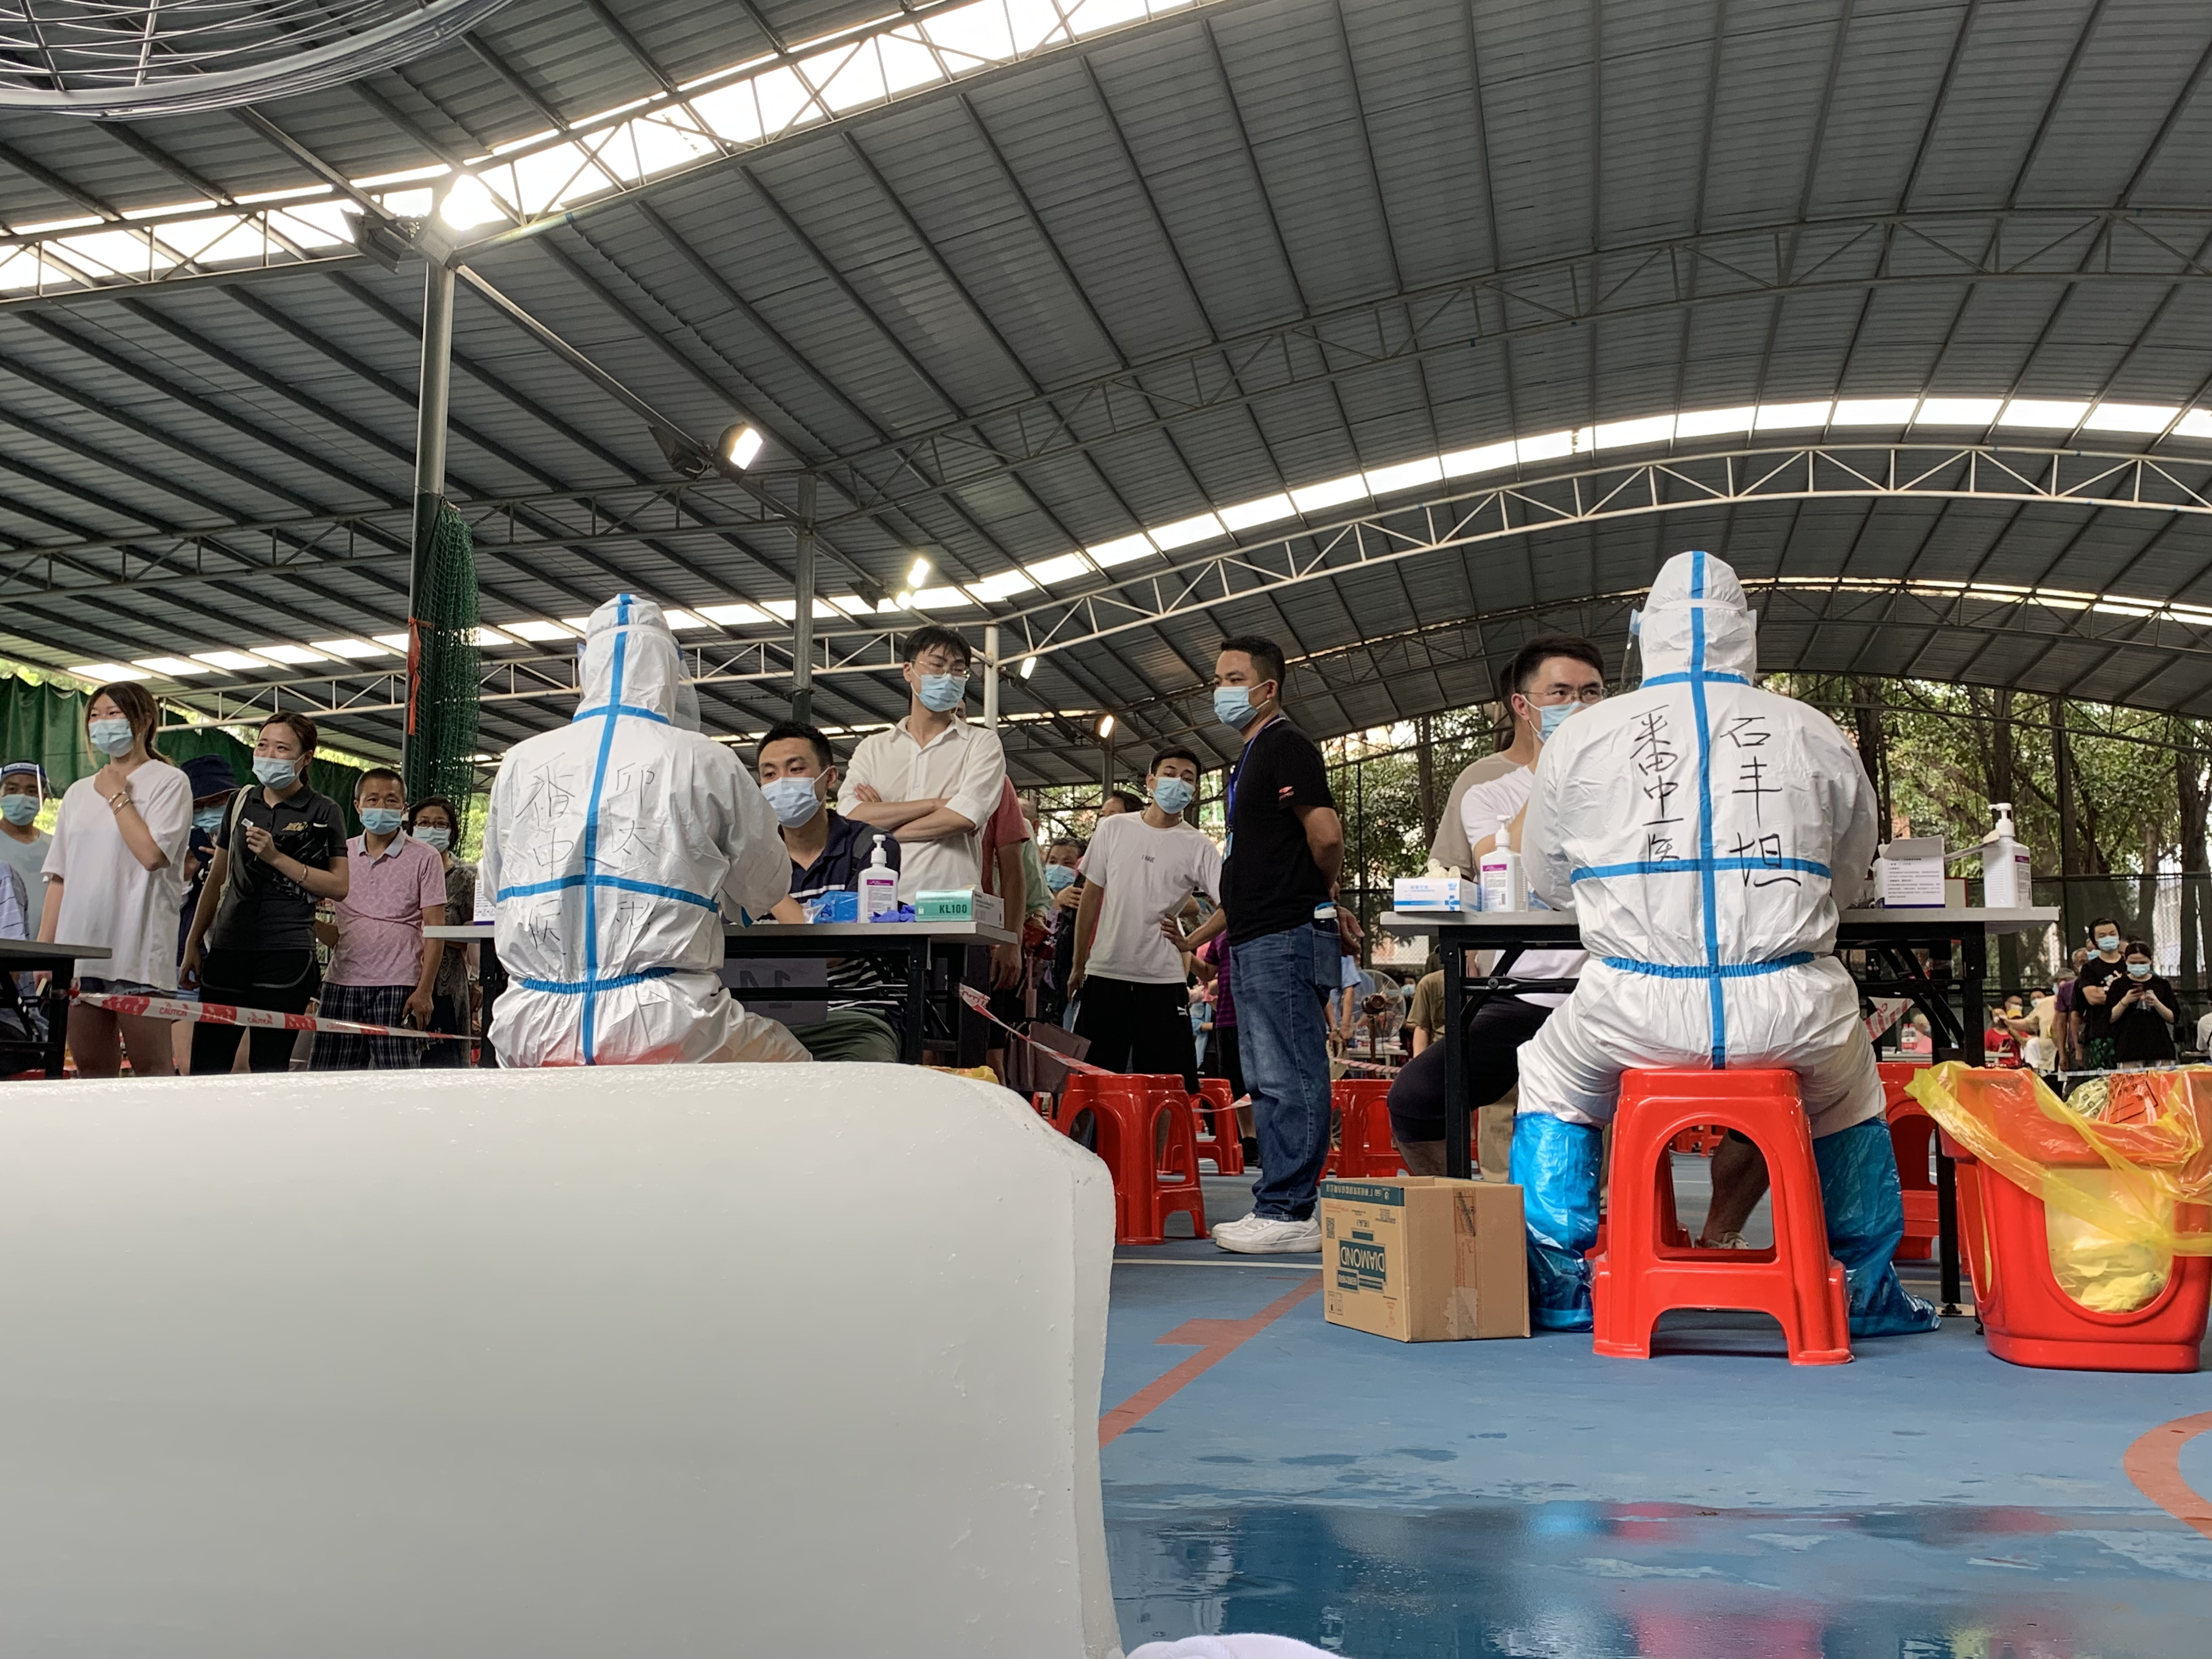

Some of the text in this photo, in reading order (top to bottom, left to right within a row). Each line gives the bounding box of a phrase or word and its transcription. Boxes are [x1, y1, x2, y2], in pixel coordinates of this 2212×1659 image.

[939, 904, 967, 913] KL100
[159, 1007, 187, 1017] CAUTION
[1340, 1246, 1385, 1272] DIAMOND
